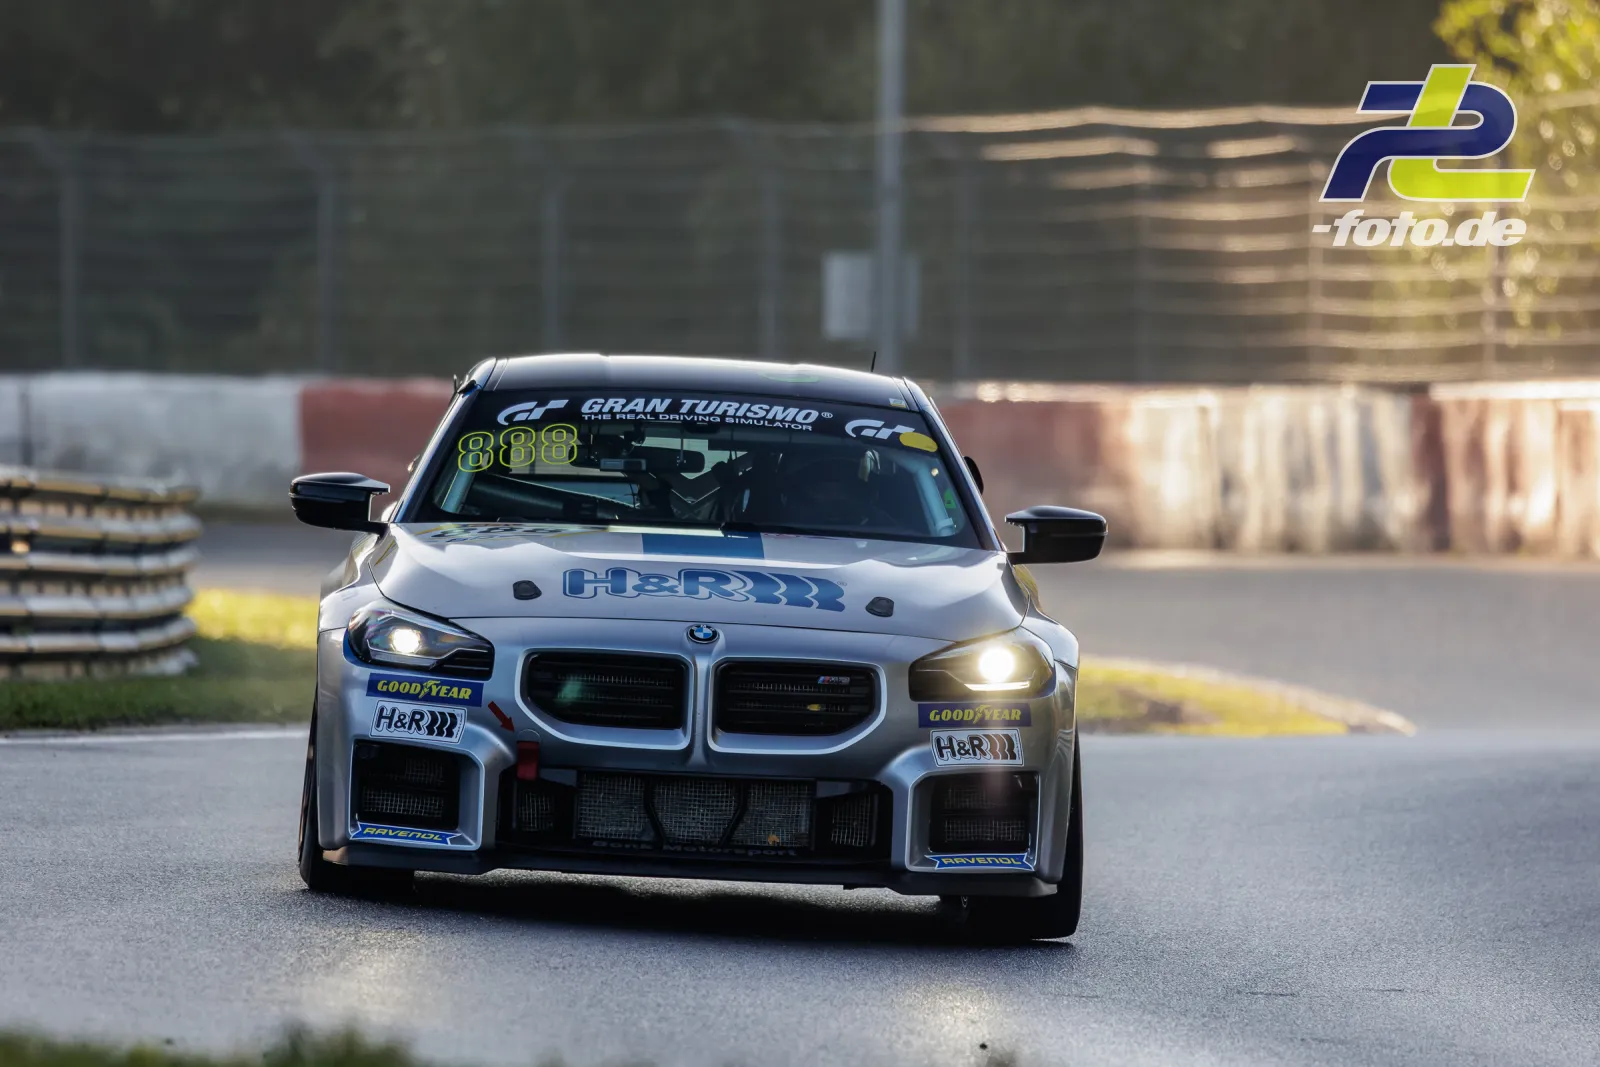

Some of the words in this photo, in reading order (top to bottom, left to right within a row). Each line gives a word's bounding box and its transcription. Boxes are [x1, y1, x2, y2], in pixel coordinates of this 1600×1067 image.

[580, 398, 673, 414] GRAN
[616, 413, 656, 421] REAL
[659, 414, 721, 423] DRIVING
[725, 417, 813, 432] SIMULATOR
[457, 423, 578, 473] 888
[374, 704, 430, 736] H&R
[934, 734, 992, 761] H&R
[362, 826, 443, 842] RAVENOL
[662, 844, 798, 857] Motorsport
[942, 857, 1022, 866] RAVENOL
